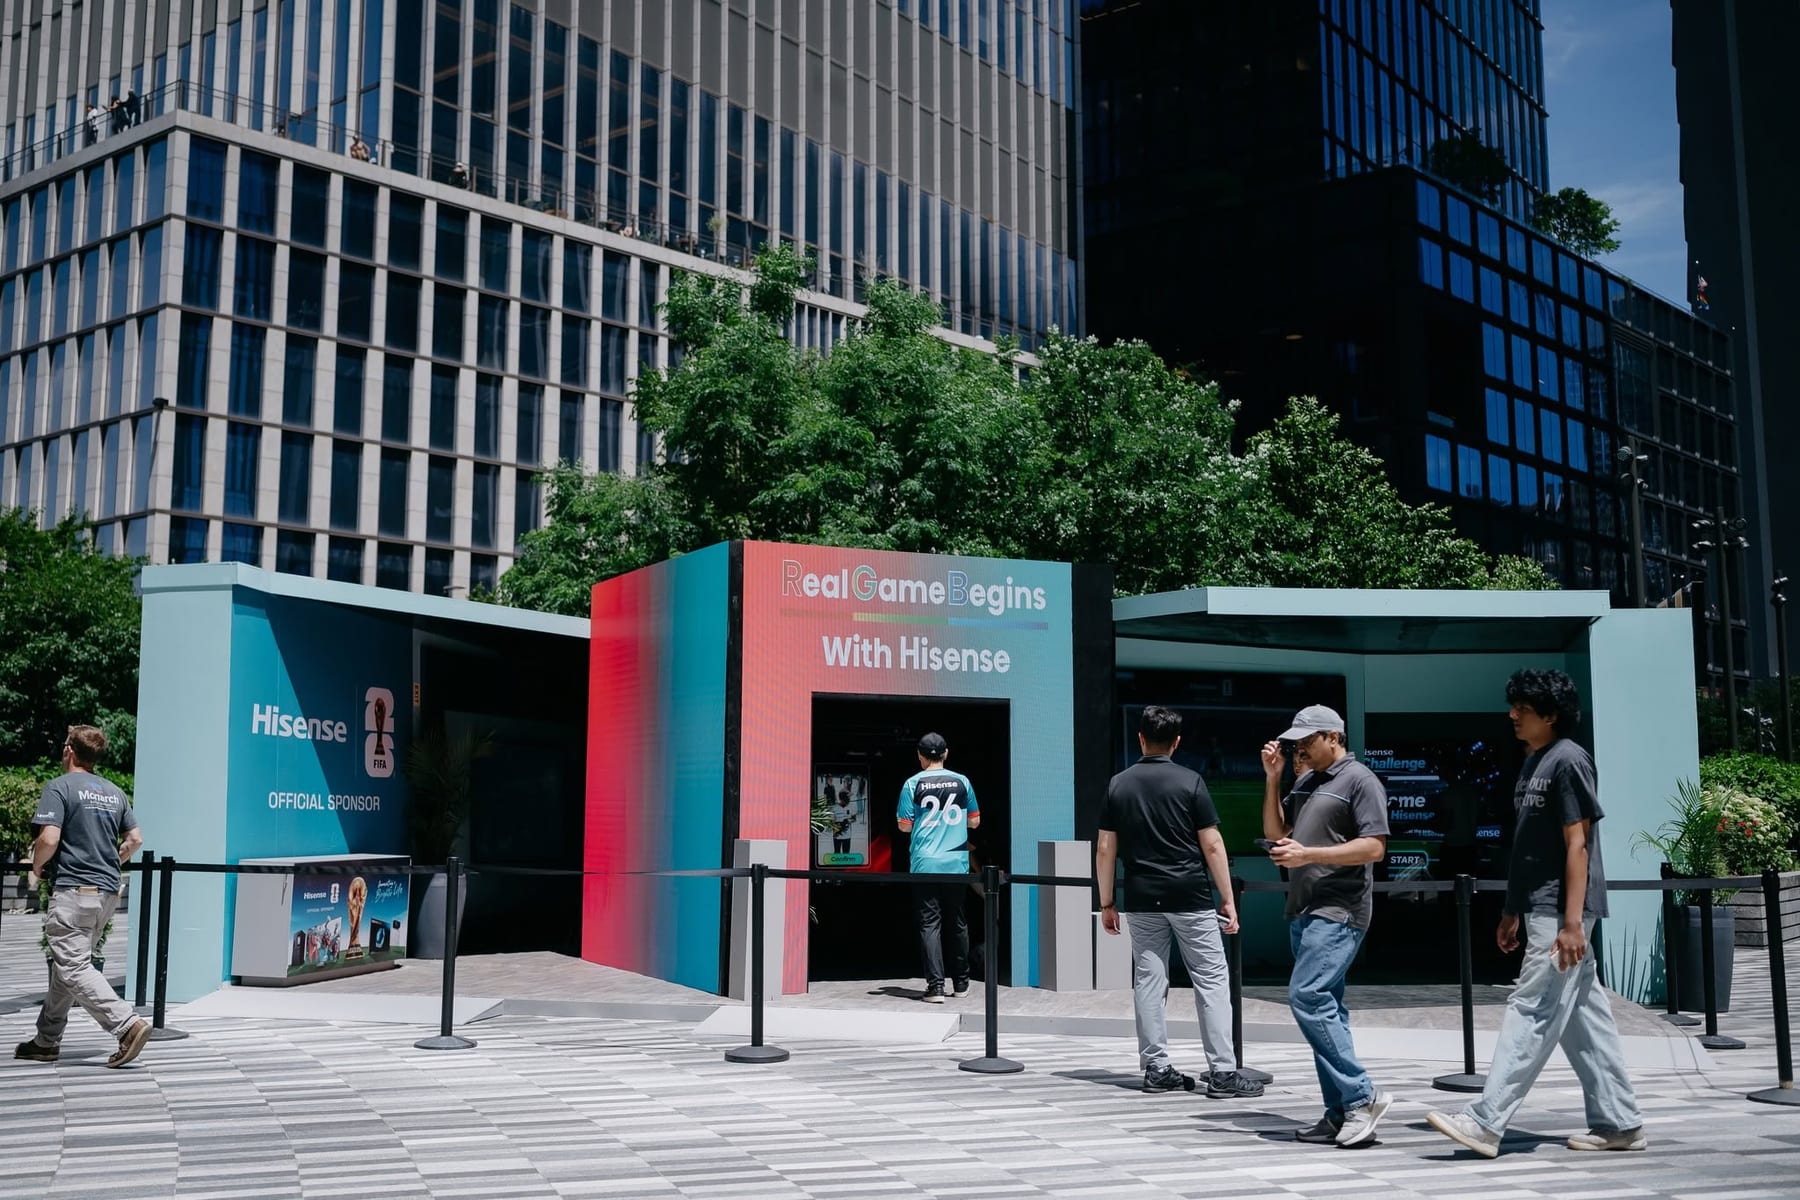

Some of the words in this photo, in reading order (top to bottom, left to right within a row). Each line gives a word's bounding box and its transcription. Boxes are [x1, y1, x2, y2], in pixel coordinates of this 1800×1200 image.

[822, 633, 892, 669] With
[900, 636, 1010, 673] Hisense
[251, 703, 348, 743] Hisense
[1364, 748, 1394, 756] isense
[373, 759, 387, 769] FIFA
[921, 781, 958, 791] Hisense
[78, 790, 120, 805] Monarch
[268, 791, 325, 811] OFFICIAL
[327, 794, 381, 812] SPONSOR
[920, 793, 962, 829] 26
[1390, 855, 1420, 865] START
